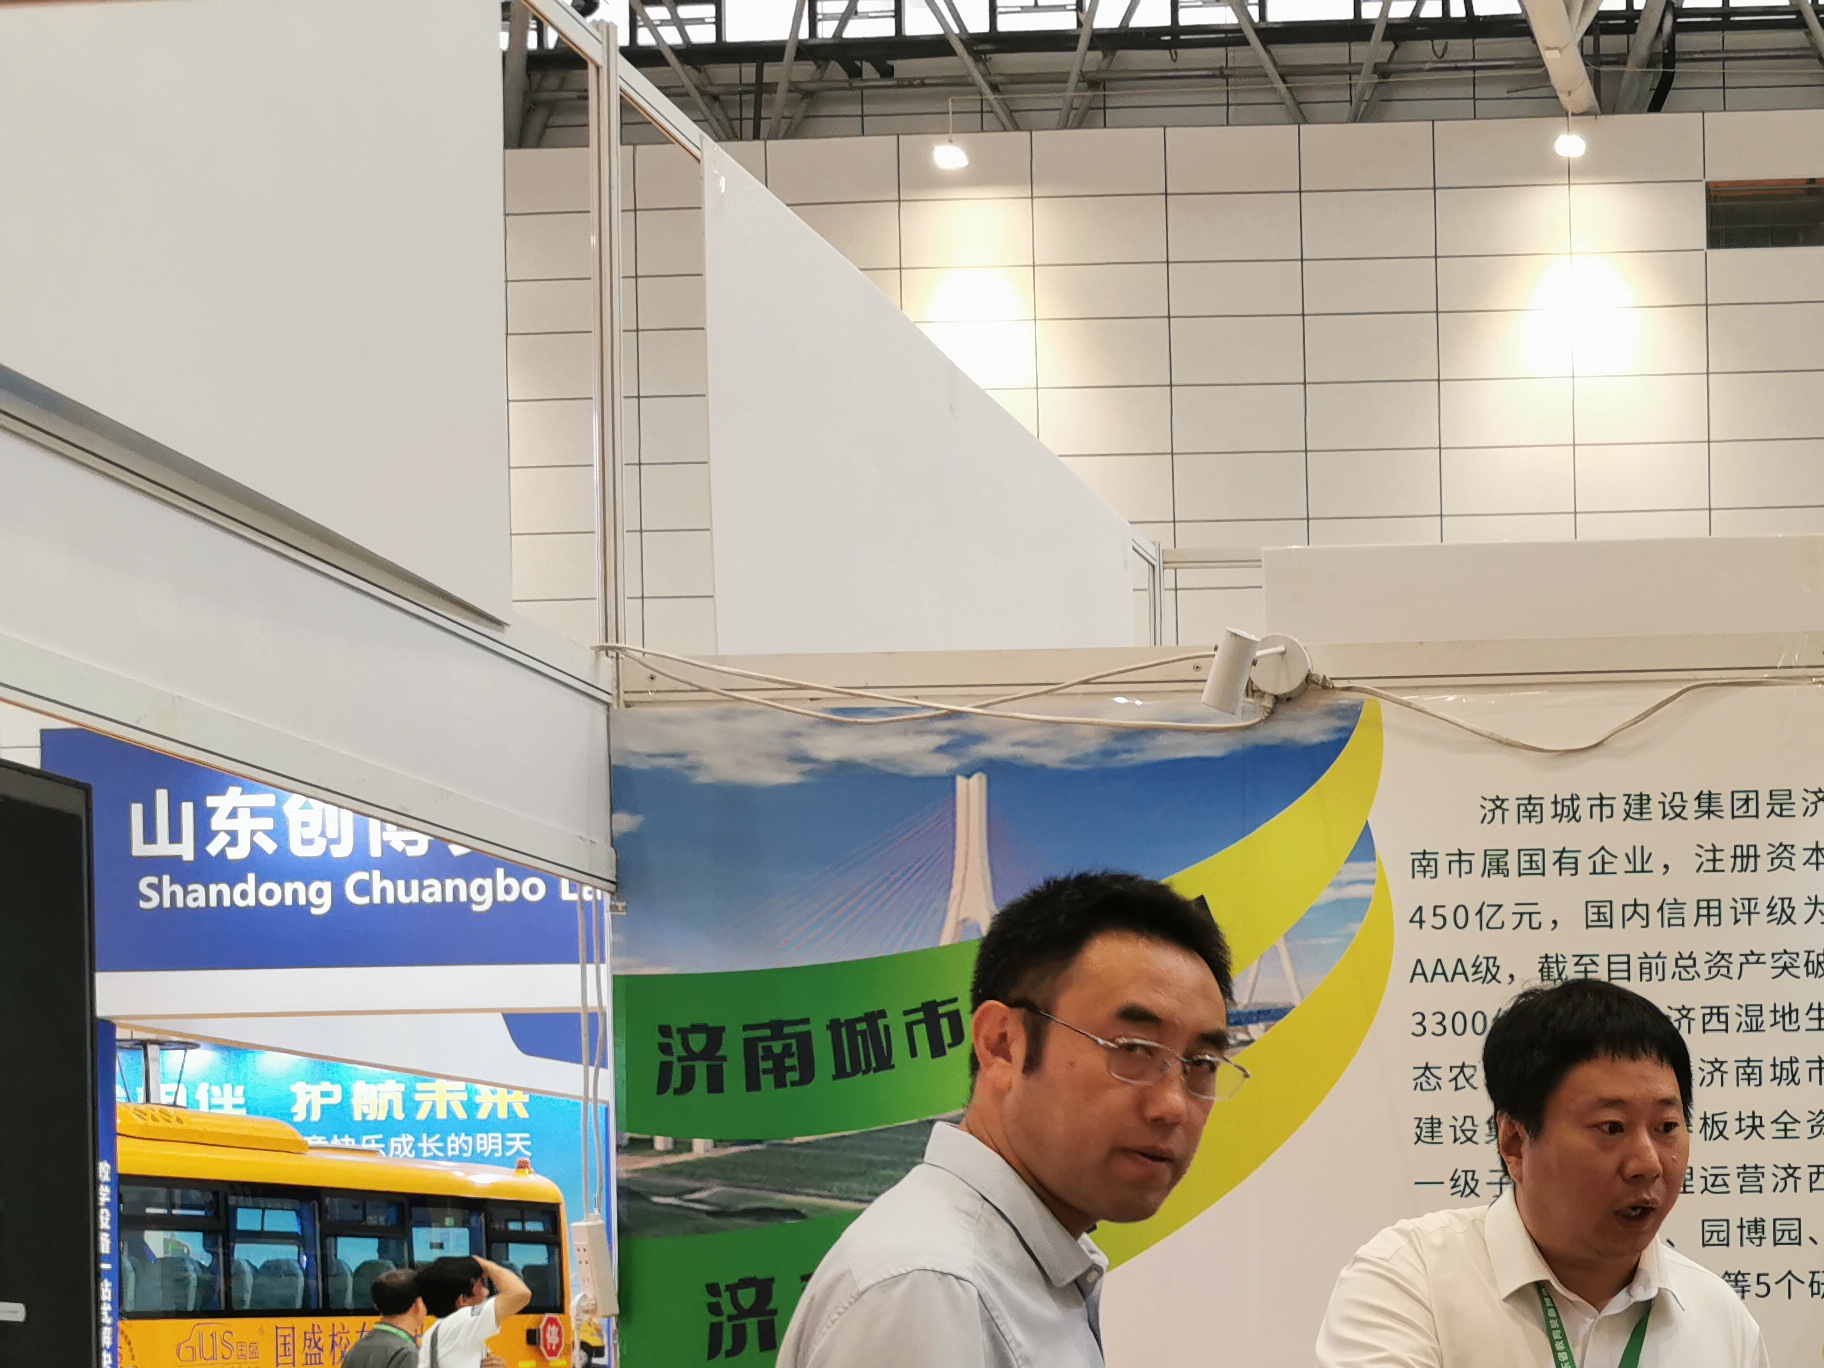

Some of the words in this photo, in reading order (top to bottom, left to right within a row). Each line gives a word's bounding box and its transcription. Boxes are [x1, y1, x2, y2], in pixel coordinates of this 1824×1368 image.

[130, 786, 472, 862] 山东创
[137, 871, 333, 916] Shandong
[345, 867, 547, 913] Chuangbo
[656, 997, 965, 1096] 济南城市
[1412, 1061, 1480, 1093] 态农
[290, 1080, 530, 1122] 护航未来
[706, 1275, 779, 1361] 济
